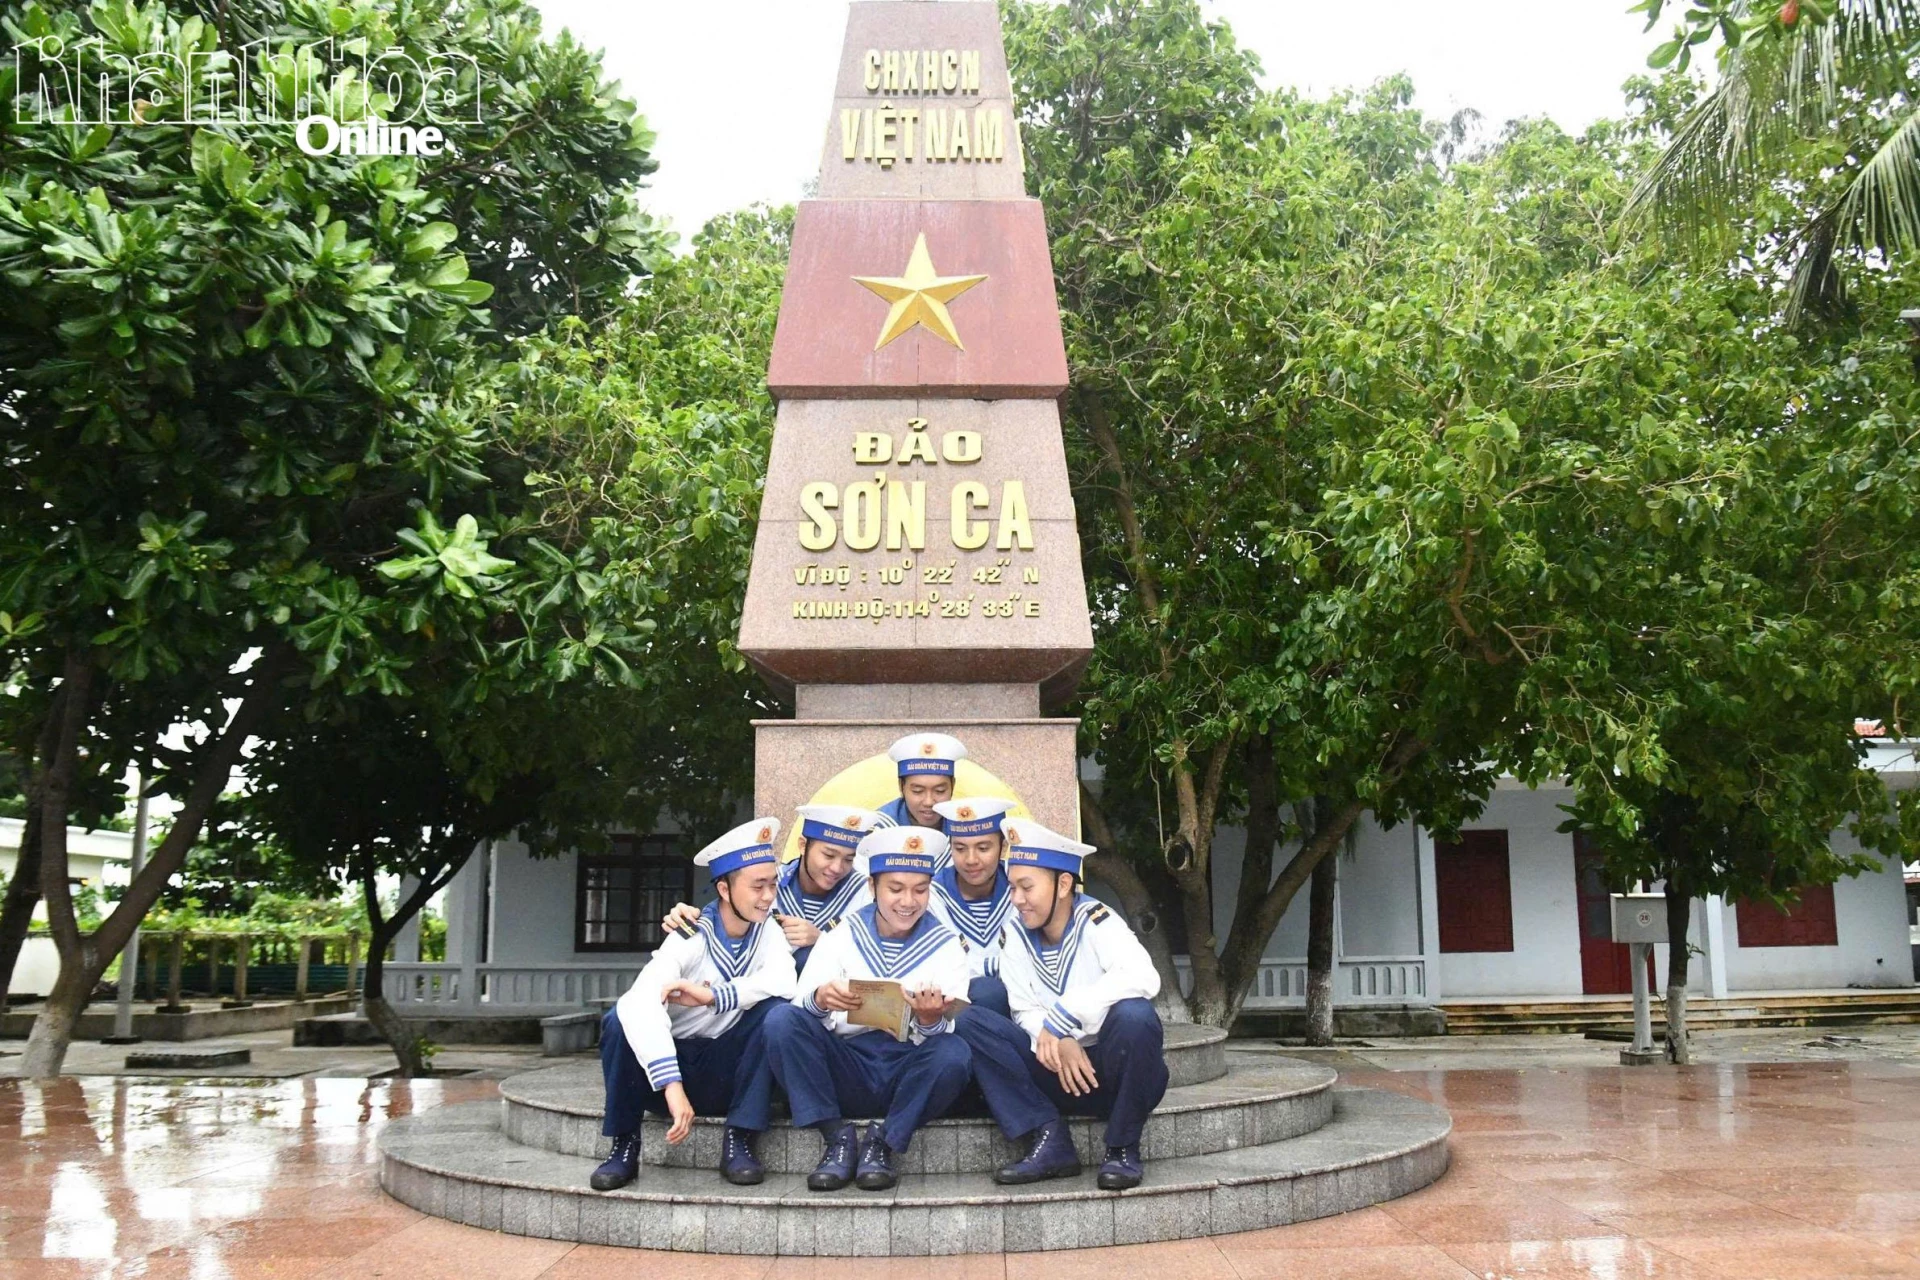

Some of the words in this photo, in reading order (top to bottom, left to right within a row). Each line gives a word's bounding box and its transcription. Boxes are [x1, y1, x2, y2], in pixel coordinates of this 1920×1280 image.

[864, 49, 979, 95] CHXHCN
[840, 100, 918, 169] VIỆT
[925, 108, 1003, 163] NAM
[852, 417, 982, 464] ĐẢO
[799, 471, 926, 551] SƠN
[950, 480, 1034, 551] CA
[1023, 566, 1039, 584] N
[793, 601, 848, 618] KINH
[1024, 601, 1040, 618] E
